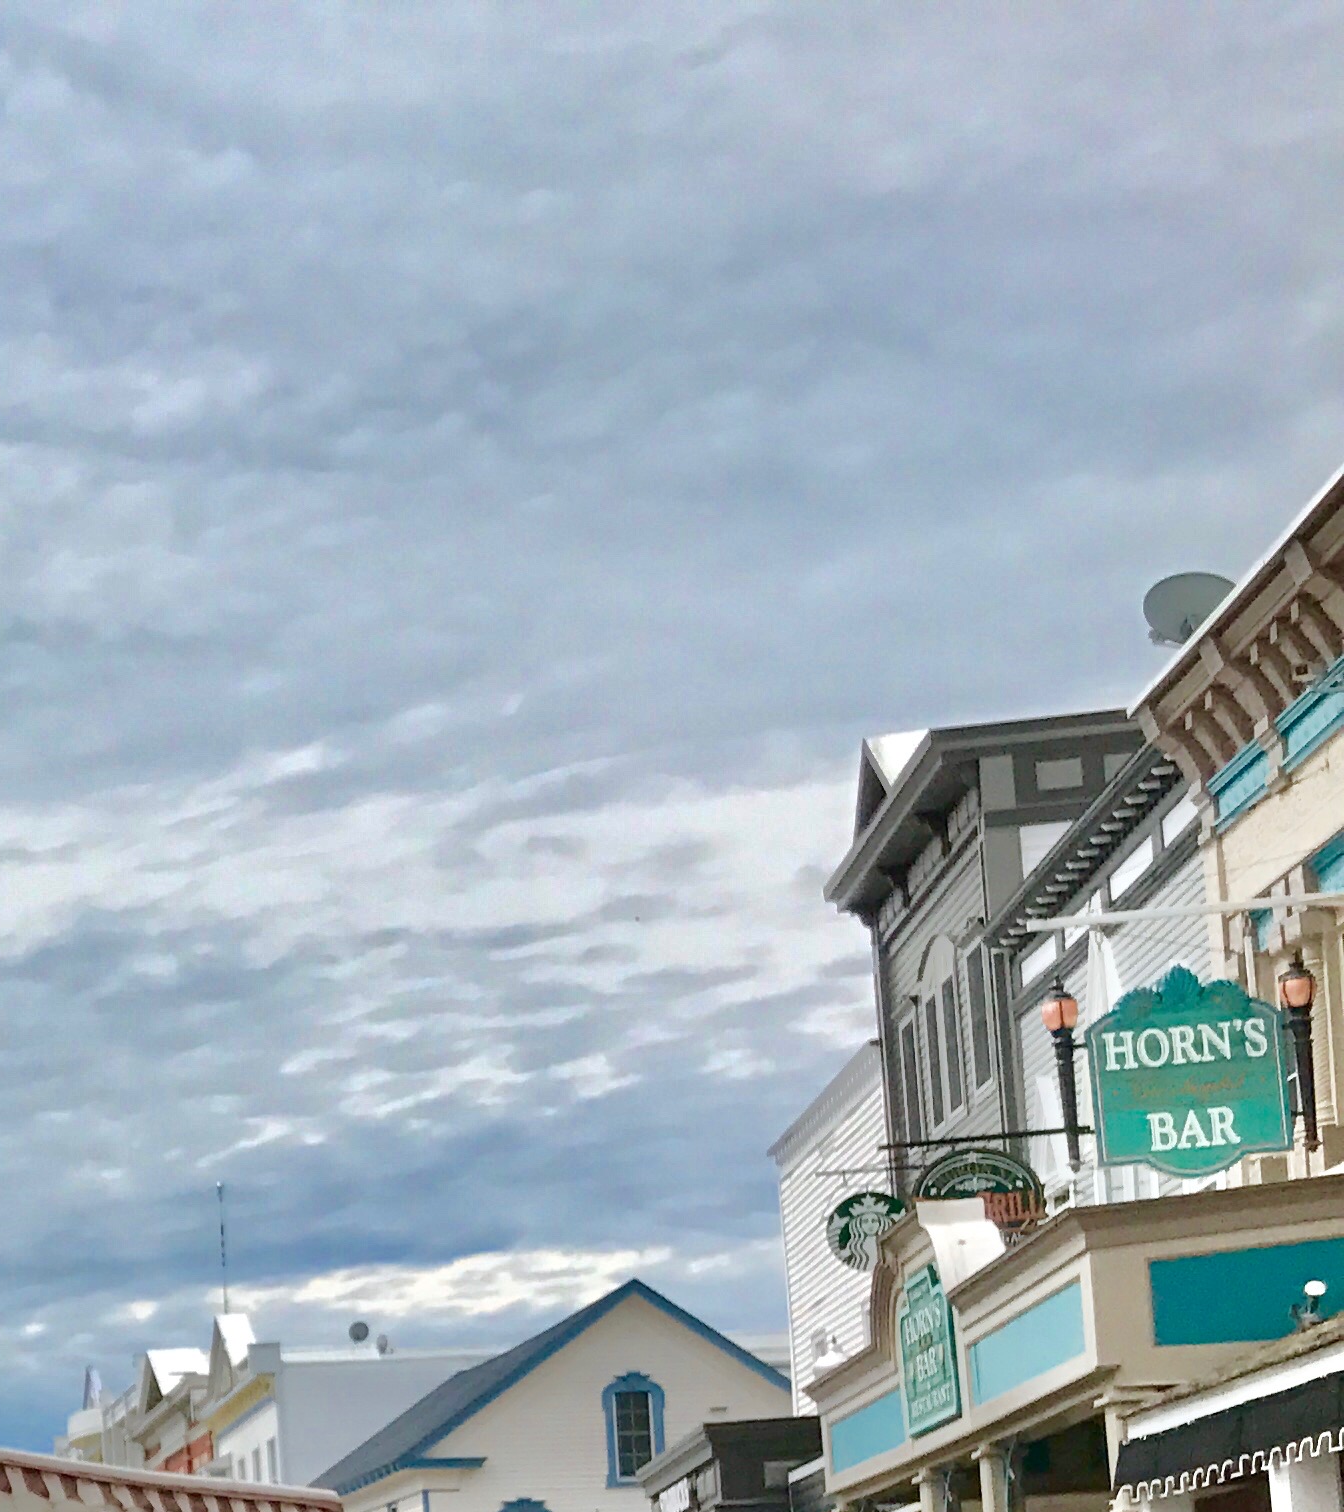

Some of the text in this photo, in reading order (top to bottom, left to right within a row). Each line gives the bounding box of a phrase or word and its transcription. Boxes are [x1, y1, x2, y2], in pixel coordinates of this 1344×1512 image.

[1101, 1018, 1269, 1072] HORN'S
[1146, 1106, 1242, 1152] BAR
[905, 1301, 942, 1346] HORN'S
[915, 1346, 939, 1382] BAR
